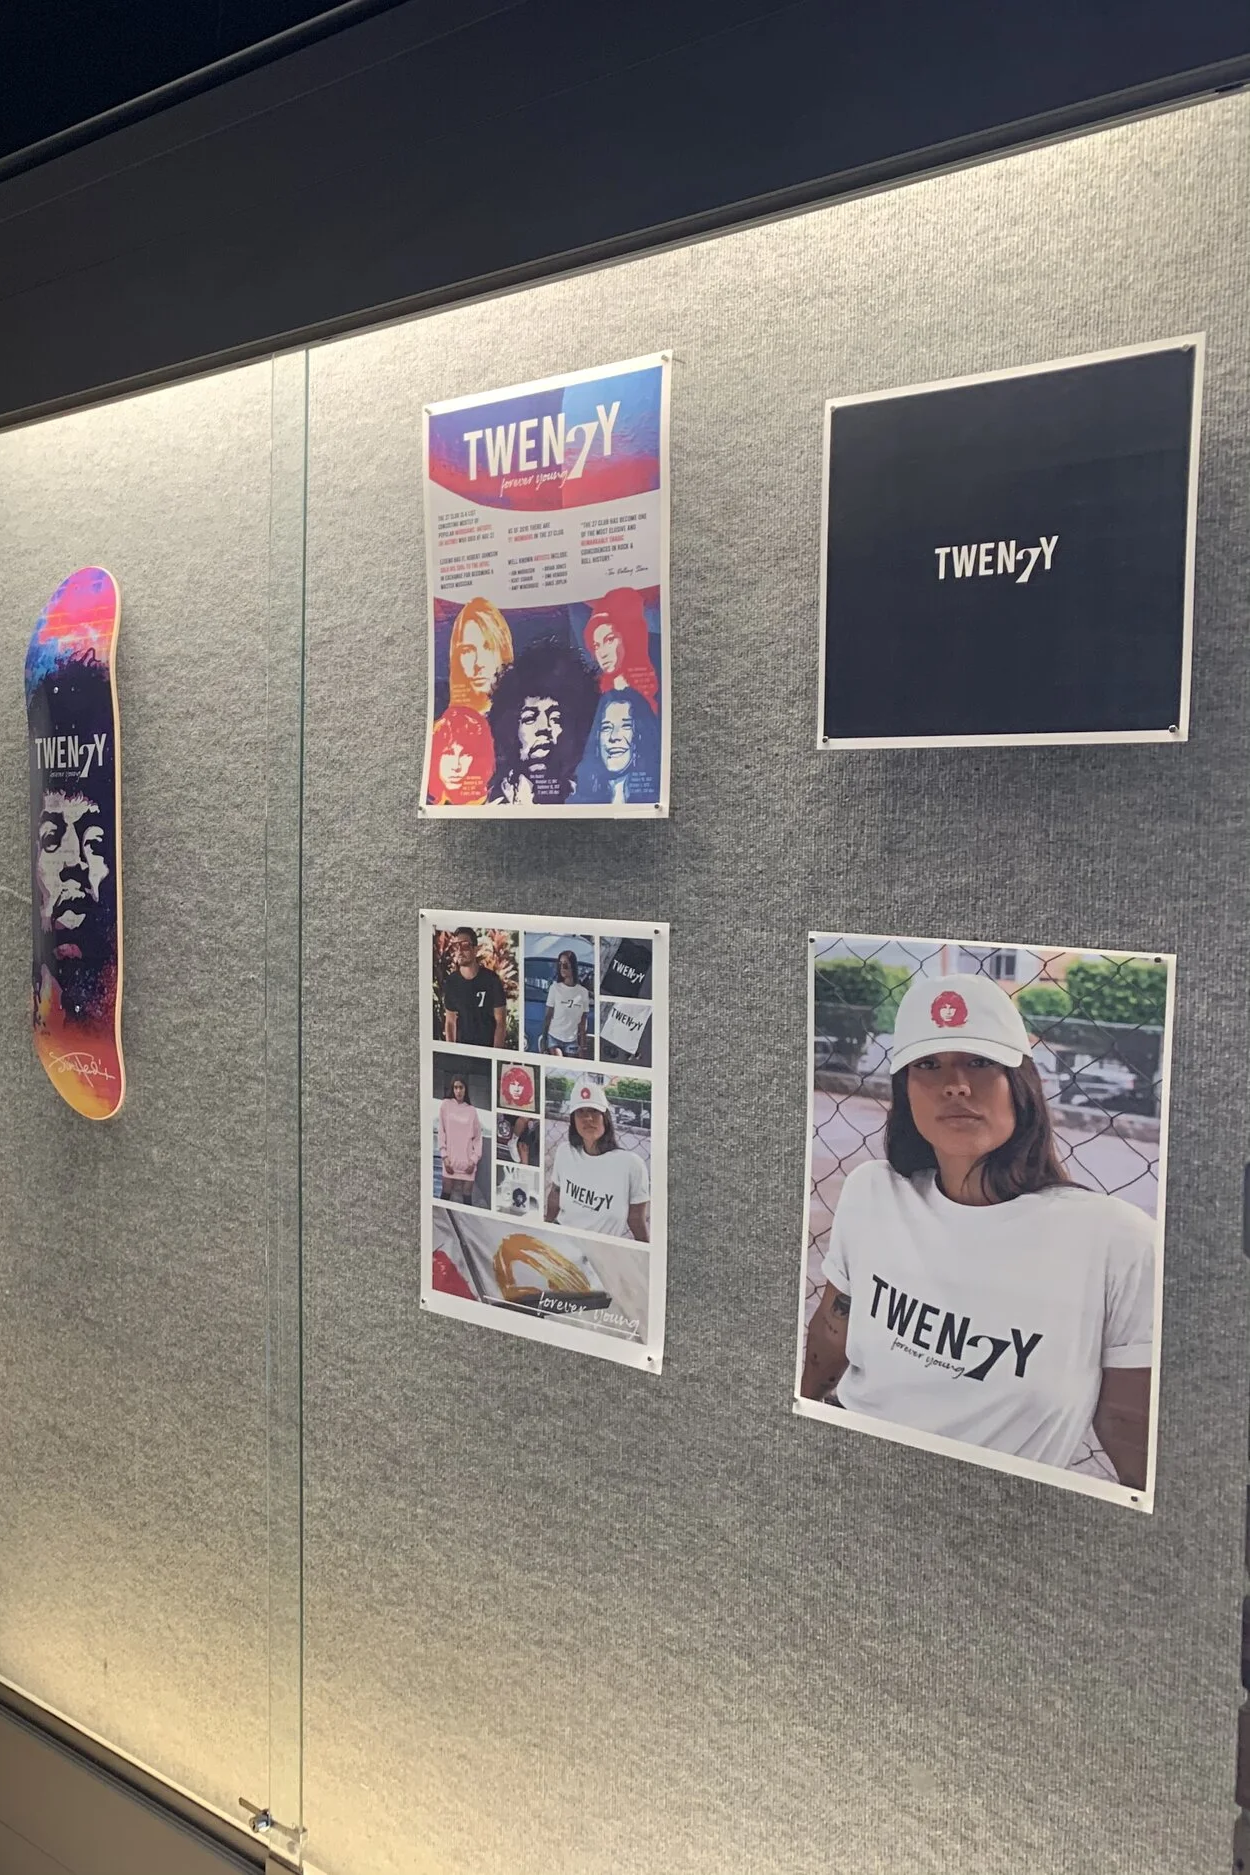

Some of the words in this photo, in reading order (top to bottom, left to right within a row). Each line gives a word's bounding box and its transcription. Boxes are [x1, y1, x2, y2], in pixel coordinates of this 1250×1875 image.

[536, 1291, 587, 1316] forever
[593, 1309, 641, 1340] young
[890, 1337, 924, 1360] forever
[924, 1356, 966, 1380] young
